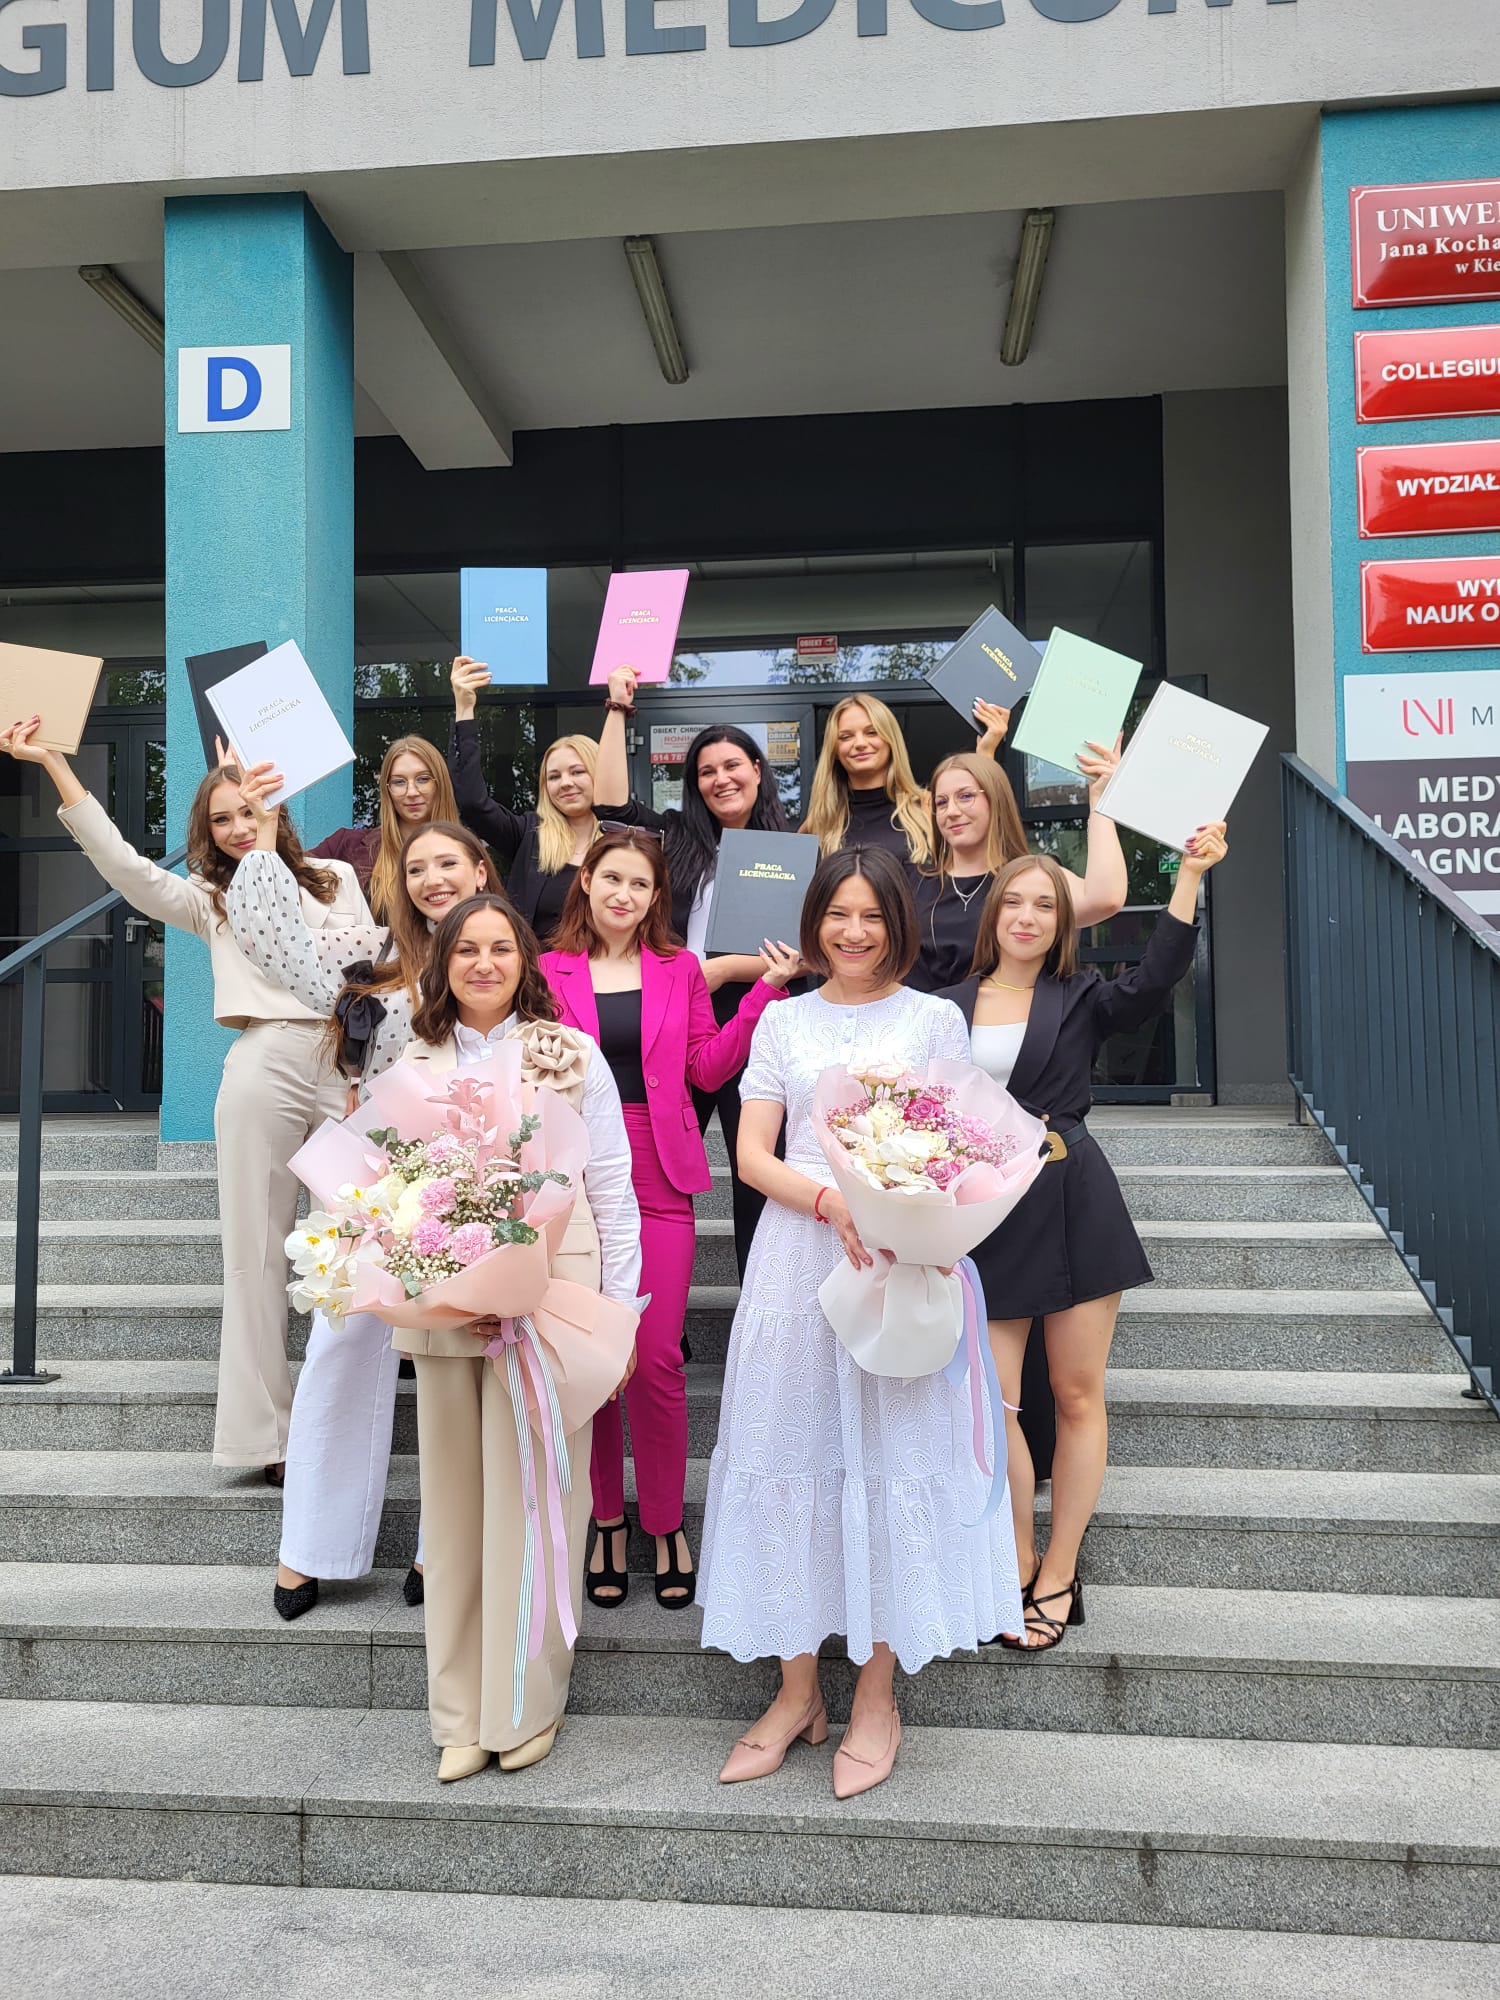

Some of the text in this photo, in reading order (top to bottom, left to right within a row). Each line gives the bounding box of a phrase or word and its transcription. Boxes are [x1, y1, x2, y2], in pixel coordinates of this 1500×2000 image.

[1376, 201, 1500, 232] UNIWE
[1379, 242, 1428, 263] Jana
[1455, 263, 1469, 274] w
[1381, 357, 1500, 382] COLLEGIU
[207, 356, 262, 422] D
[1396, 473, 1500, 498] WYDZIAŁ
[1456, 579, 1500, 598] WY
[484, 615, 529, 623] LICENCJACKA
[1406, 604, 1475, 625] NAUK
[248, 698, 302, 733] LICENCJACKA
[257, 697, 284, 716] PRACA
[1418, 775, 1500, 803] MED
[739, 869, 796, 881] LICENCJACKA
[754, 862, 783, 872] PRACA
